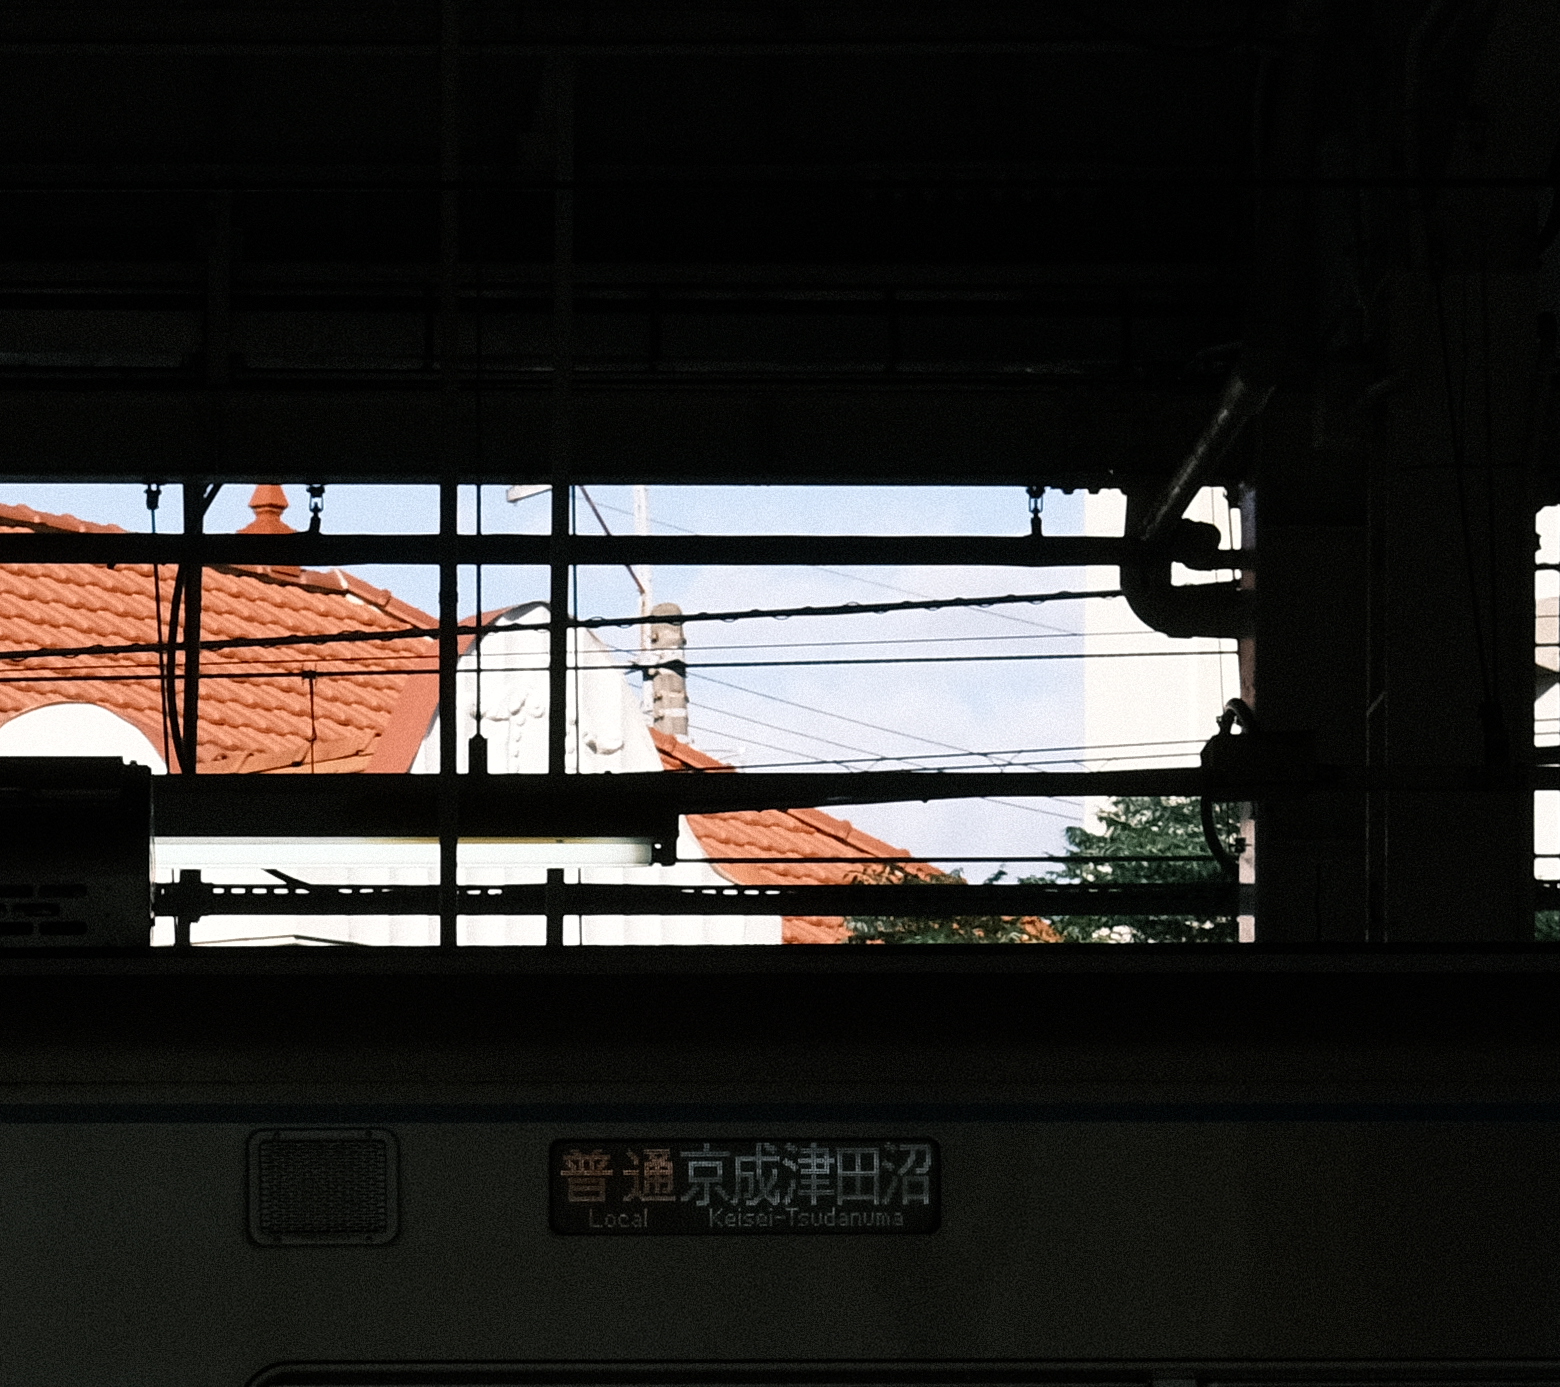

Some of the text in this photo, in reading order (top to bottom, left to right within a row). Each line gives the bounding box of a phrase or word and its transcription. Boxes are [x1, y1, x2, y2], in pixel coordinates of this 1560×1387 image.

[559, 1143, 933, 1207] 普通 京成津田沼
[588, 1206, 904, 1229] Local Keisei-Tsudanuma
